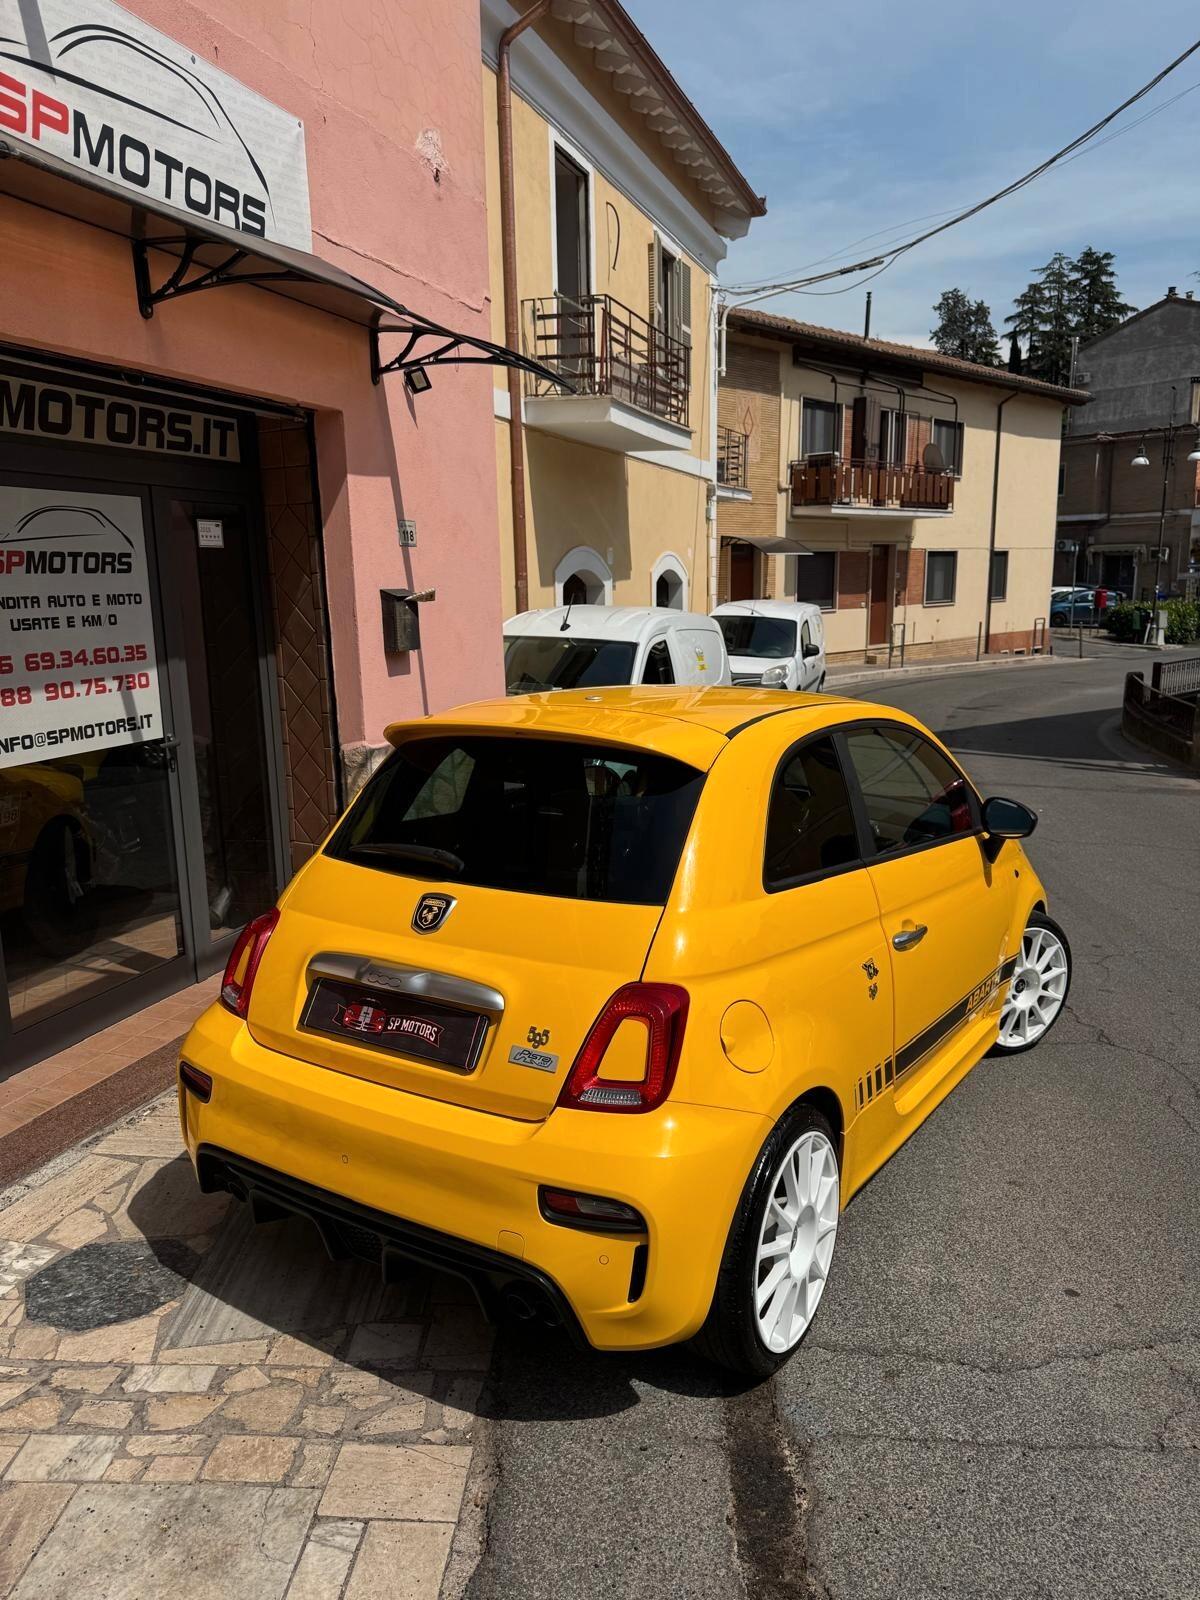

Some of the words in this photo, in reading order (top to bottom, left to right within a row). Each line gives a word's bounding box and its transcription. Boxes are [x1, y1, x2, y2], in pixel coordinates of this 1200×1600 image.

[402, 530, 414, 542] 118
[48, 595, 86, 608] AUTO
[92, 594, 100, 606] E
[107, 593, 142, 606] MOTO
[10, 617, 60, 632] USATE
[66, 616, 75, 628] E
[24, 644, 147, 672] 69.34.60.35
[0, 686, 32, 707] 88
[44, 672, 150, 701] 90.75.730
[387, 1017, 401, 1031] SP
[400, 1019, 438, 1042] MOTORS
[527, 1026, 550, 1049] 595
